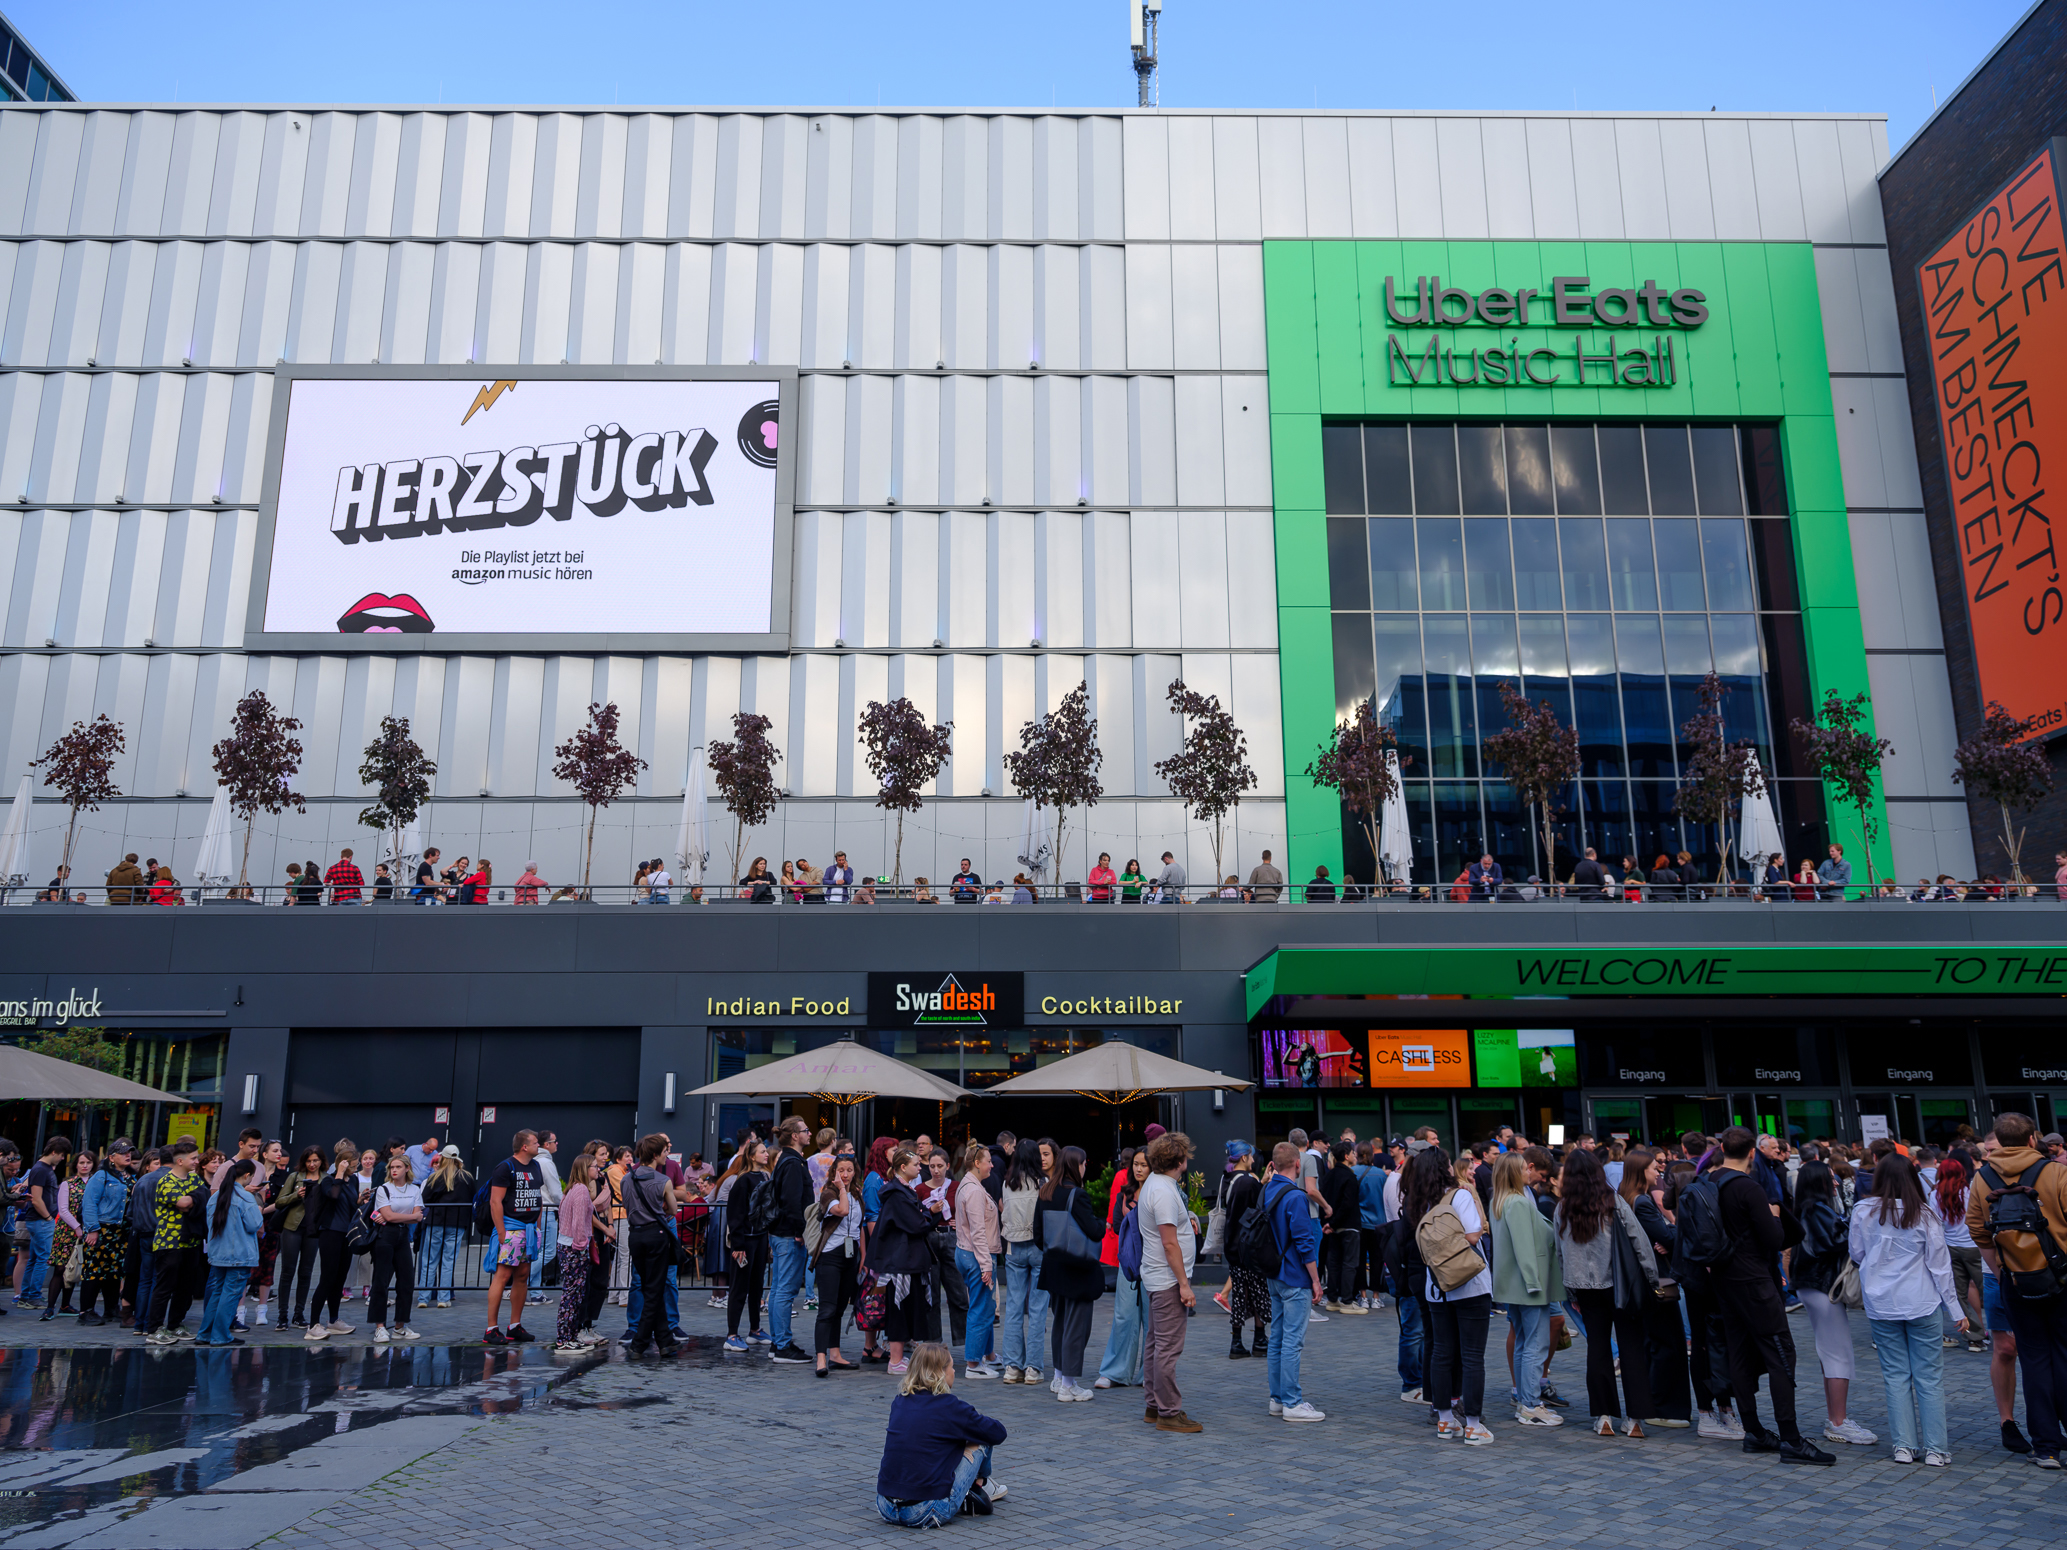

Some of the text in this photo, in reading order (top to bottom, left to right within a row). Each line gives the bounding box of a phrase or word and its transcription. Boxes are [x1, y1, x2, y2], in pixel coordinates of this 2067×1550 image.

[2006, 161, 2065, 317] LIVE
[1384, 275, 1710, 327] Uber Eats
[1387, 333, 1677, 385] Music Hall
[1924, 258, 2009, 603] AM BESTEN
[330, 422, 718, 545] HERZSTÜCK
[461, 550, 584, 566] Die Playlist jetzt bei
[451, 566, 593, 580] amazon music hören
[1516, 956, 2067, 985] WELCOME TO THE
[896, 983, 995, 1011] Swadesh
[1041, 996, 1182, 1014] Cocktailbar
[31, 997, 54, 1017] im
[55, 987, 103, 1025] glück
[707, 997, 849, 1015] Indian Food
[24, 1017, 37, 1026] BAR
[1376, 1050, 1462, 1064] CASHLESS
[786, 1062, 877, 1074] Amar
[1619, 1068, 1666, 1082] Eingang
[1755, 1068, 1801, 1082] Eingang
[1887, 1068, 1934, 1081] Eingang
[2022, 1067, 2067, 1081] Eingang
[514, 1198, 537, 1207] STATE
